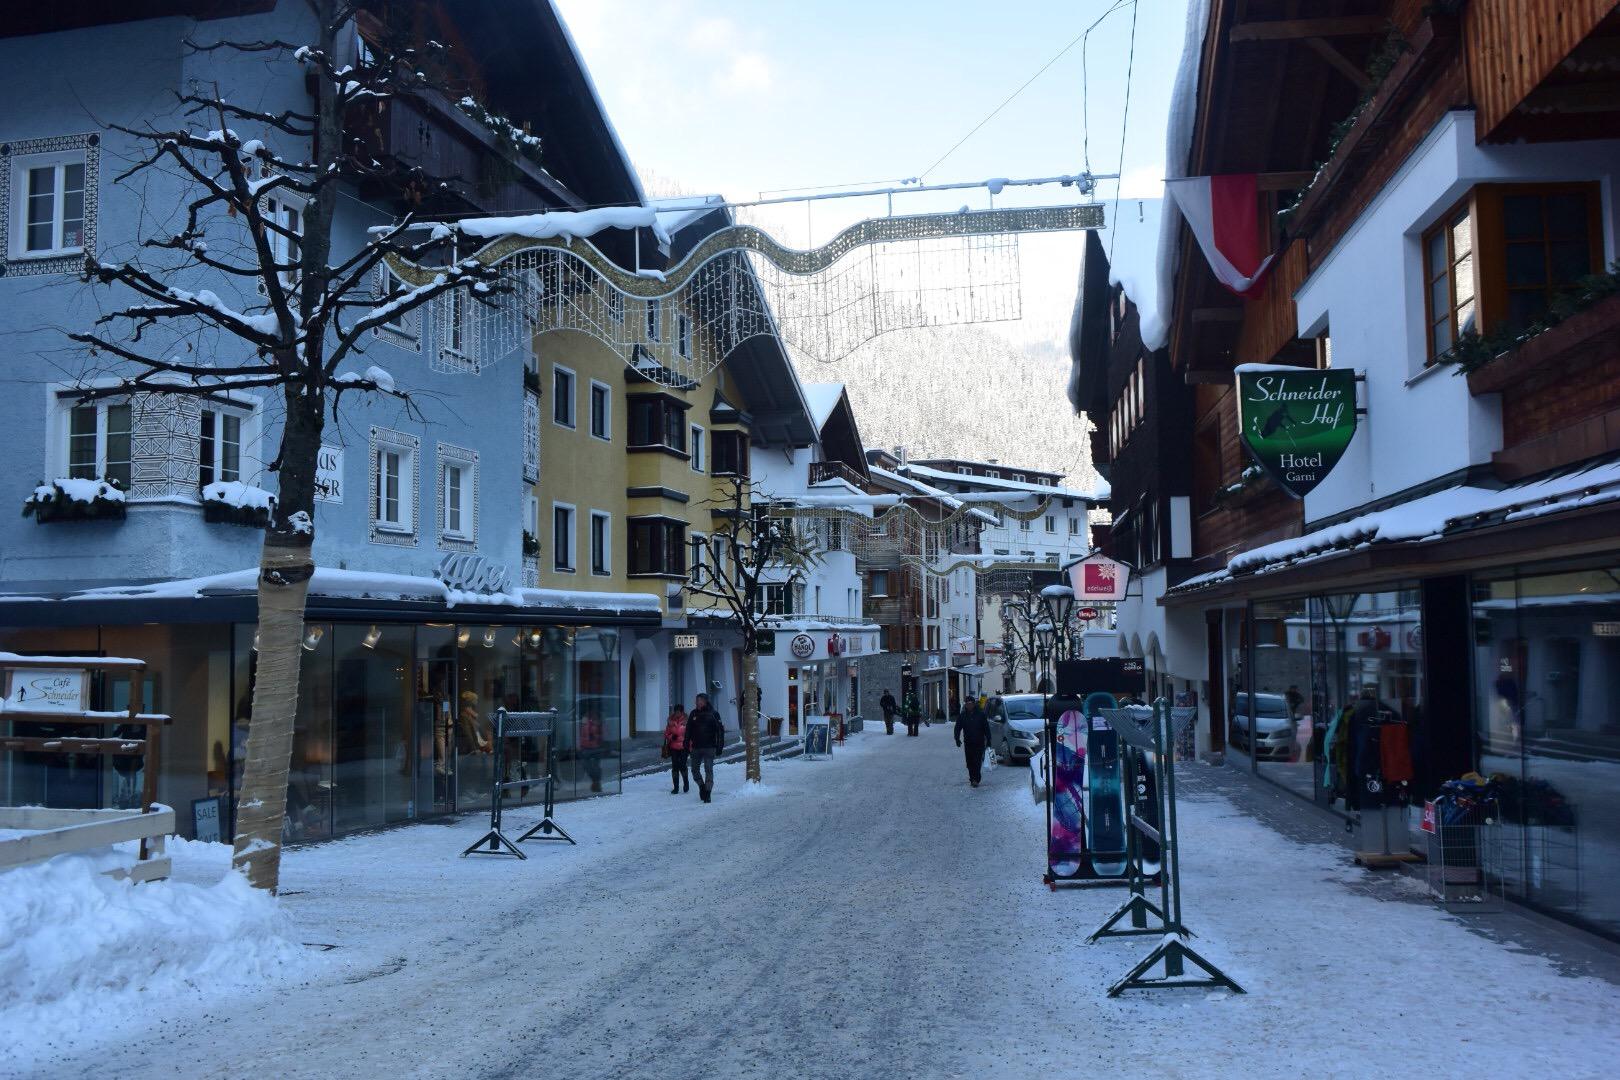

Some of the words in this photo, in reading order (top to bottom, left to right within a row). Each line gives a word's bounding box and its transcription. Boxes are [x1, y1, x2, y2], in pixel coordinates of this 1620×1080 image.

[1248, 376, 1342, 401] Schneider
[1300, 402, 1345, 430] Hof
[1279, 452, 1323, 468] Hotel
[1285, 471, 1316, 482] Garni
[53, 677, 71, 688] Café
[197, 806, 216, 820] SALE
